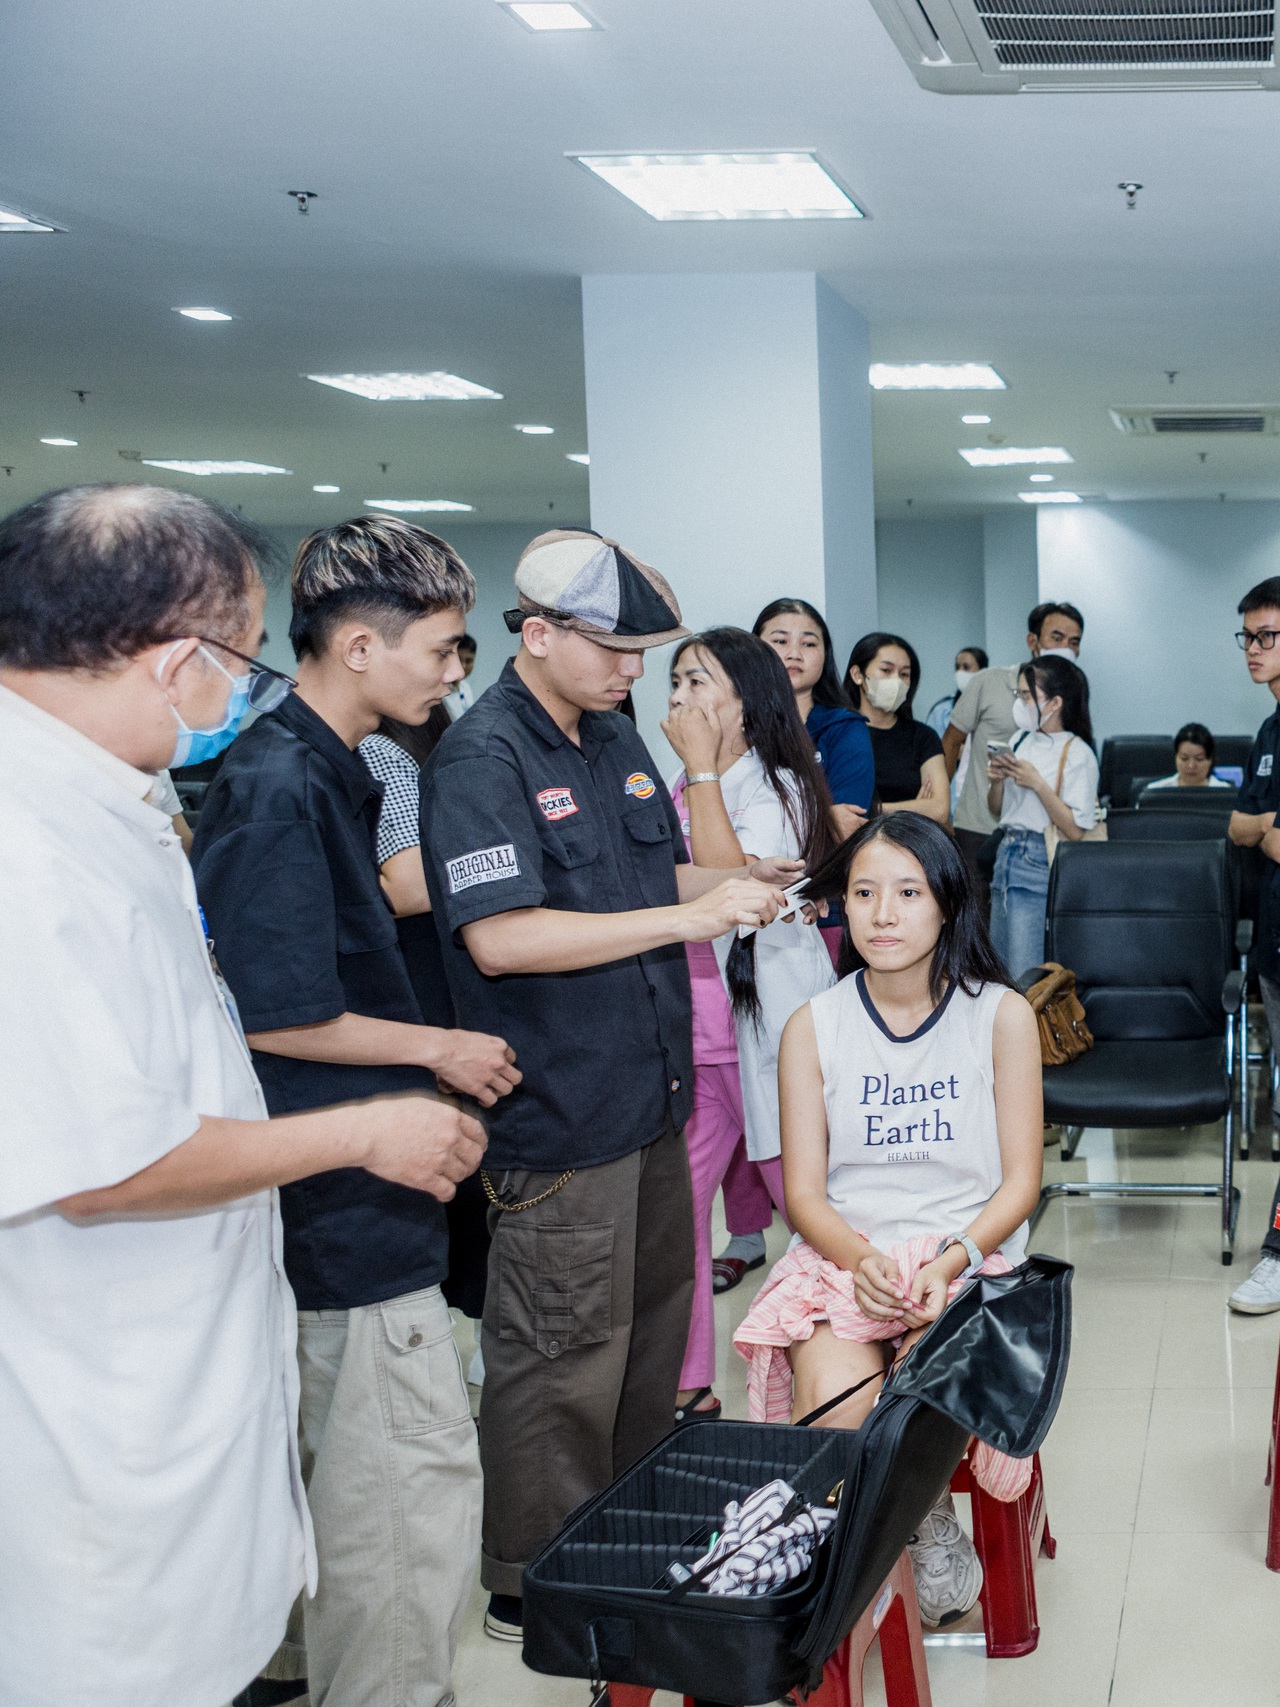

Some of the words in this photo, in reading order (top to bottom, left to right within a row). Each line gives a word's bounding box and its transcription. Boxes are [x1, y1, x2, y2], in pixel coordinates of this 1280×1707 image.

[450, 848, 516, 882] ORIGINAL
[453, 874, 483, 891] BARBER
[485, 867, 517, 880] HOUSE
[859, 1073, 960, 1106] Planet
[863, 1107, 955, 1146] Earth
[887, 1151, 930, 1162] HEALTH
